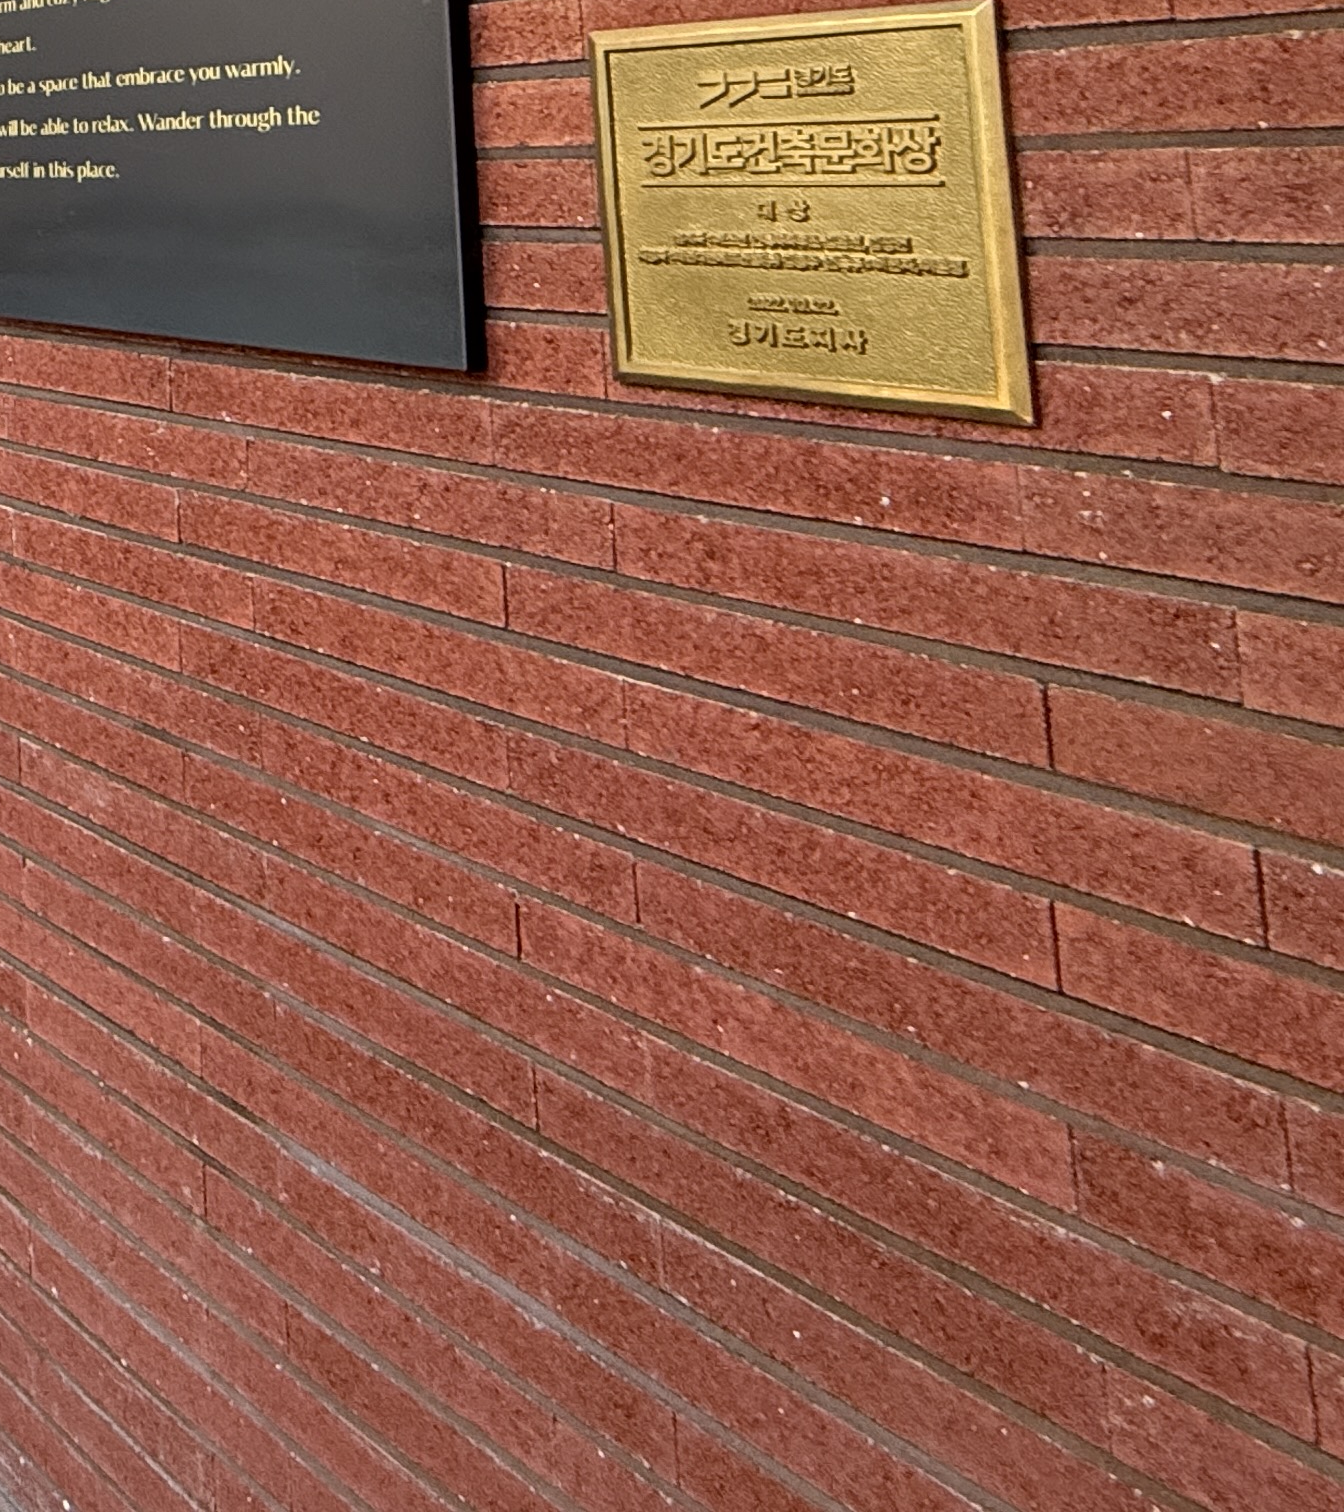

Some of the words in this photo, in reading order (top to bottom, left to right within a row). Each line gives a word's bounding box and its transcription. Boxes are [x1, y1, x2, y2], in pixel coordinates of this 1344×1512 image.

[7, 78, 25, 96] be
[27, 81, 36, 94] a
[38, 77, 78, 97] space
[82, 71, 112, 90] that
[116, 67, 185, 87] embrace
[189, 64, 221, 87] you
[224, 54, 301, 80] warmly.
[794, 65, 855, 89] 경기도
[20, 119, 38, 136] be
[40, 117, 69, 136] able
[73, 118, 89, 134] to
[92, 114, 135, 134] relax.
[137, 110, 205, 132] Wander
[209, 106, 282, 133] through
[287, 105, 321, 126] the
[641, 127, 942, 177] 경기도건축문화상
[33, 162, 45, 178] in
[48, 160, 74, 178] this
[77, 160, 120, 183] place.
[728, 319, 868, 355] 경기도지사
